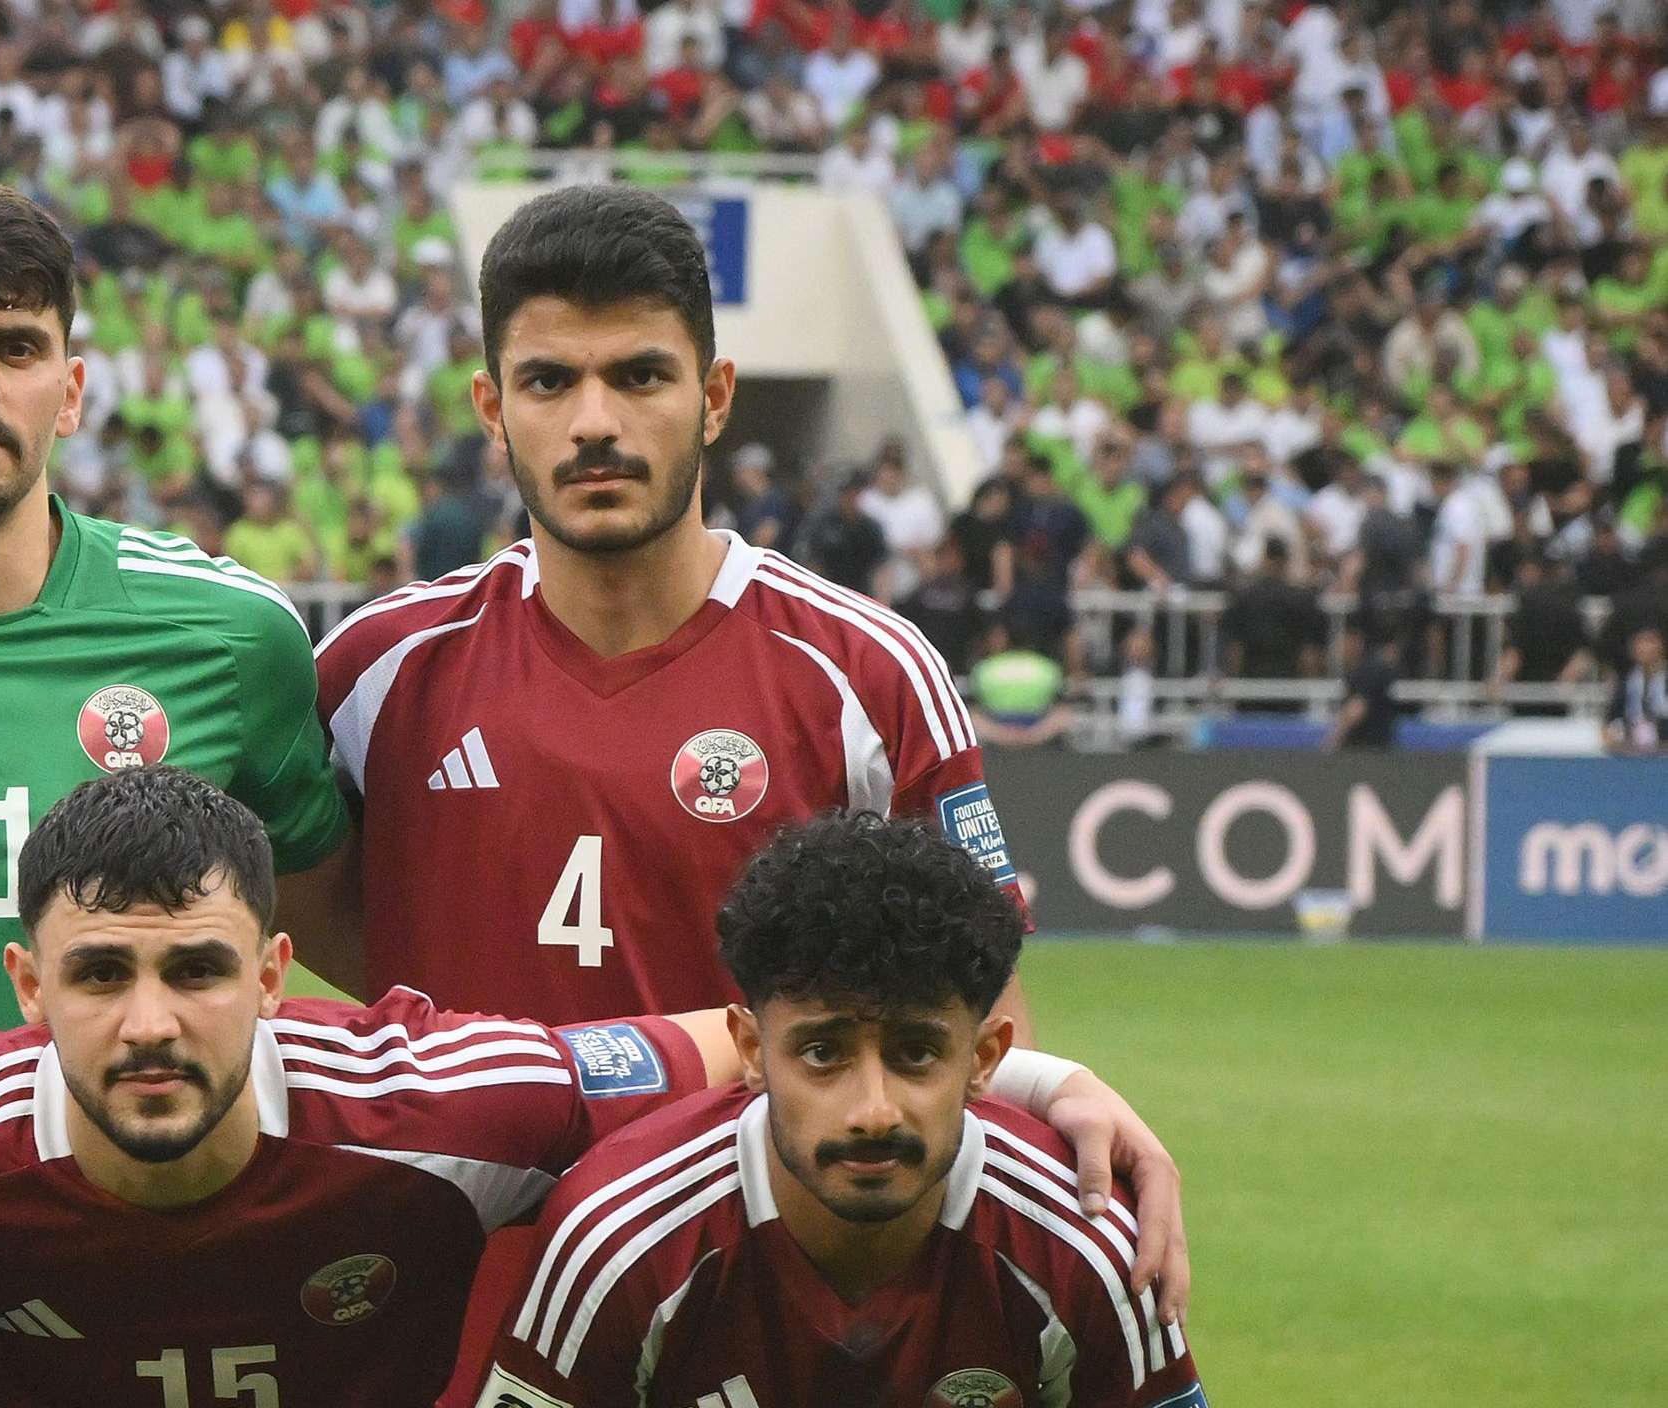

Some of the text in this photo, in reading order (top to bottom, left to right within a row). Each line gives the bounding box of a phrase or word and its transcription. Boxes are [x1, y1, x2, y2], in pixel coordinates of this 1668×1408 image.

[104, 750, 144, 768] QFA
[694, 795, 737, 817] QFA
[537, 834, 615, 968] 4
[333, 1300, 376, 1321] QFA
